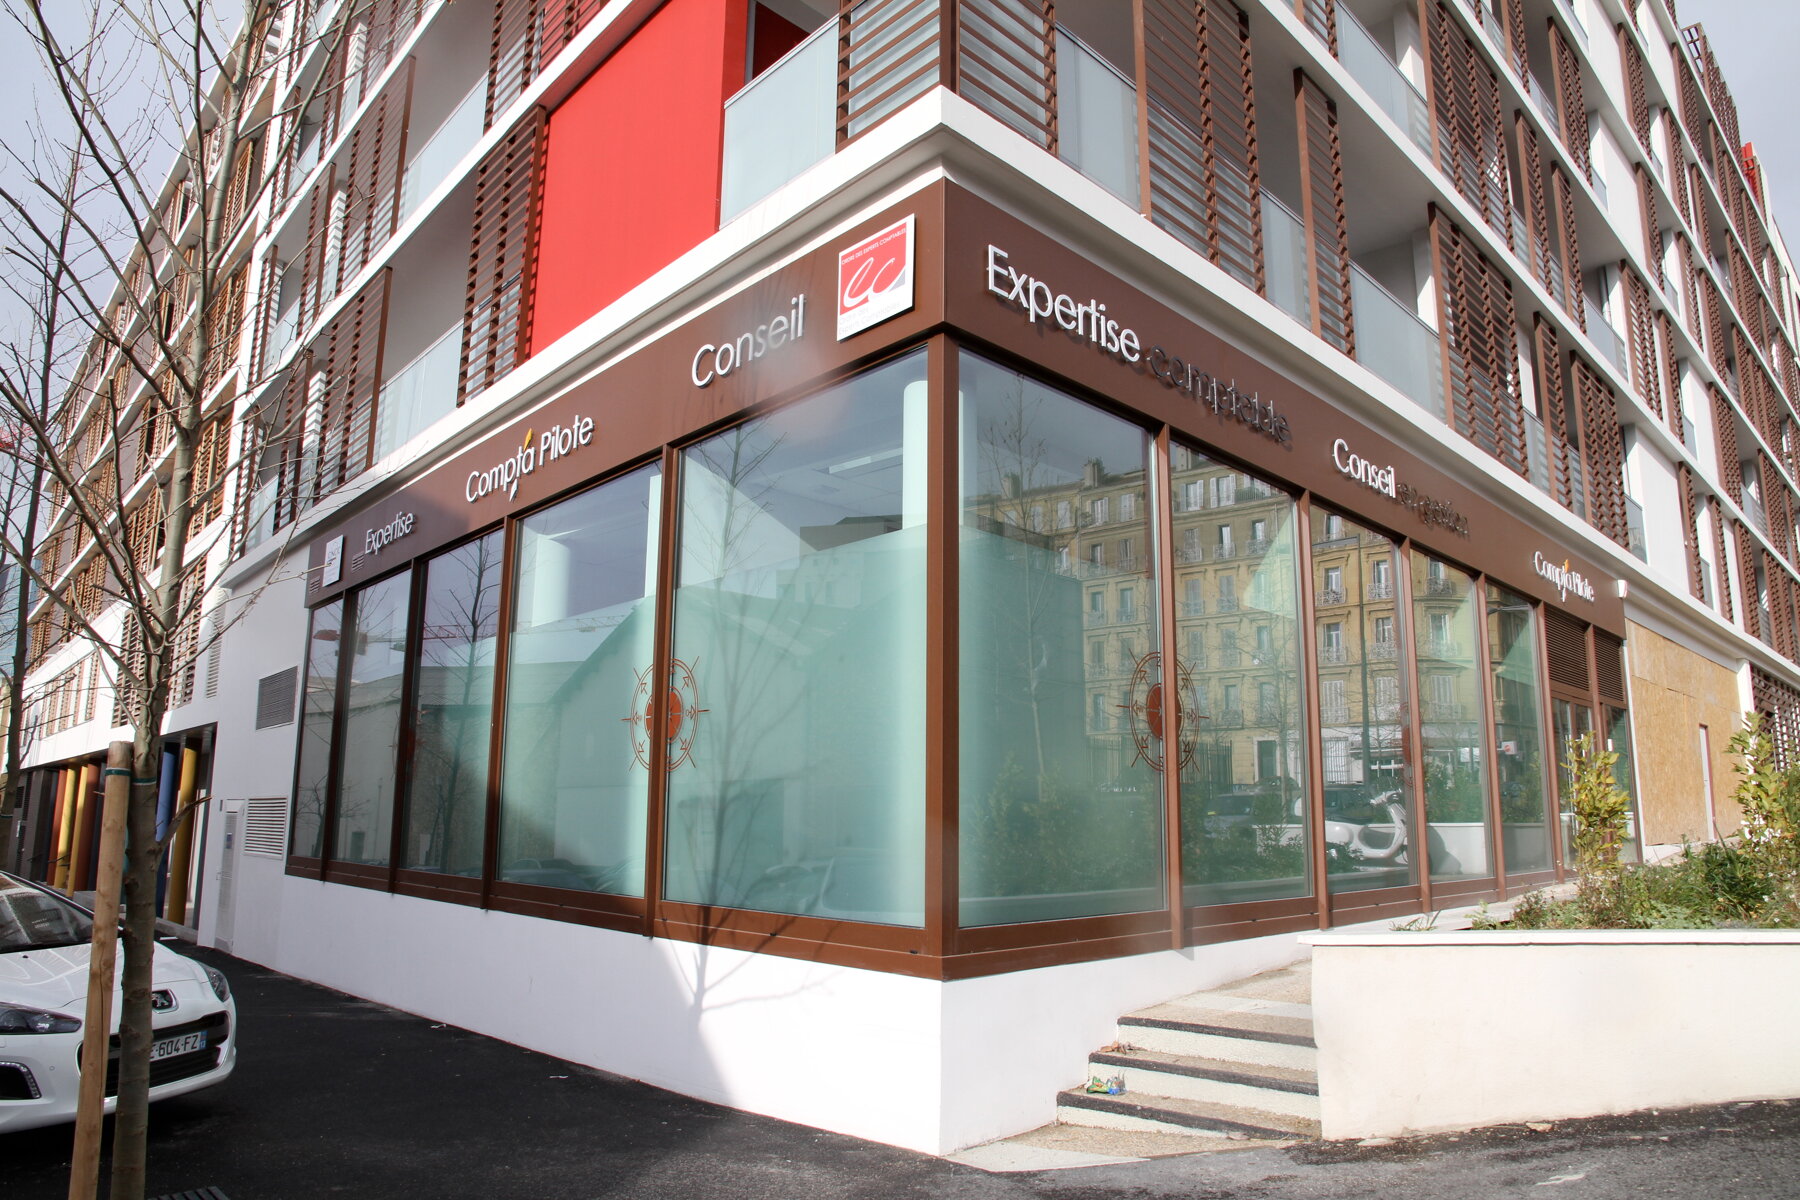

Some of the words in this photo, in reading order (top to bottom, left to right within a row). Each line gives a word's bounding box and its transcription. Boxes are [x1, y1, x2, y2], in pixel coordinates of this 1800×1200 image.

[691, 293, 805, 388] Conseil
[988, 244, 1141, 362] Expertise
[465, 428, 536, 503] Compta
[538, 414, 595, 467] Pilote
[1333, 438, 1397, 498] Conseil
[364, 511, 415, 556] Expertise
